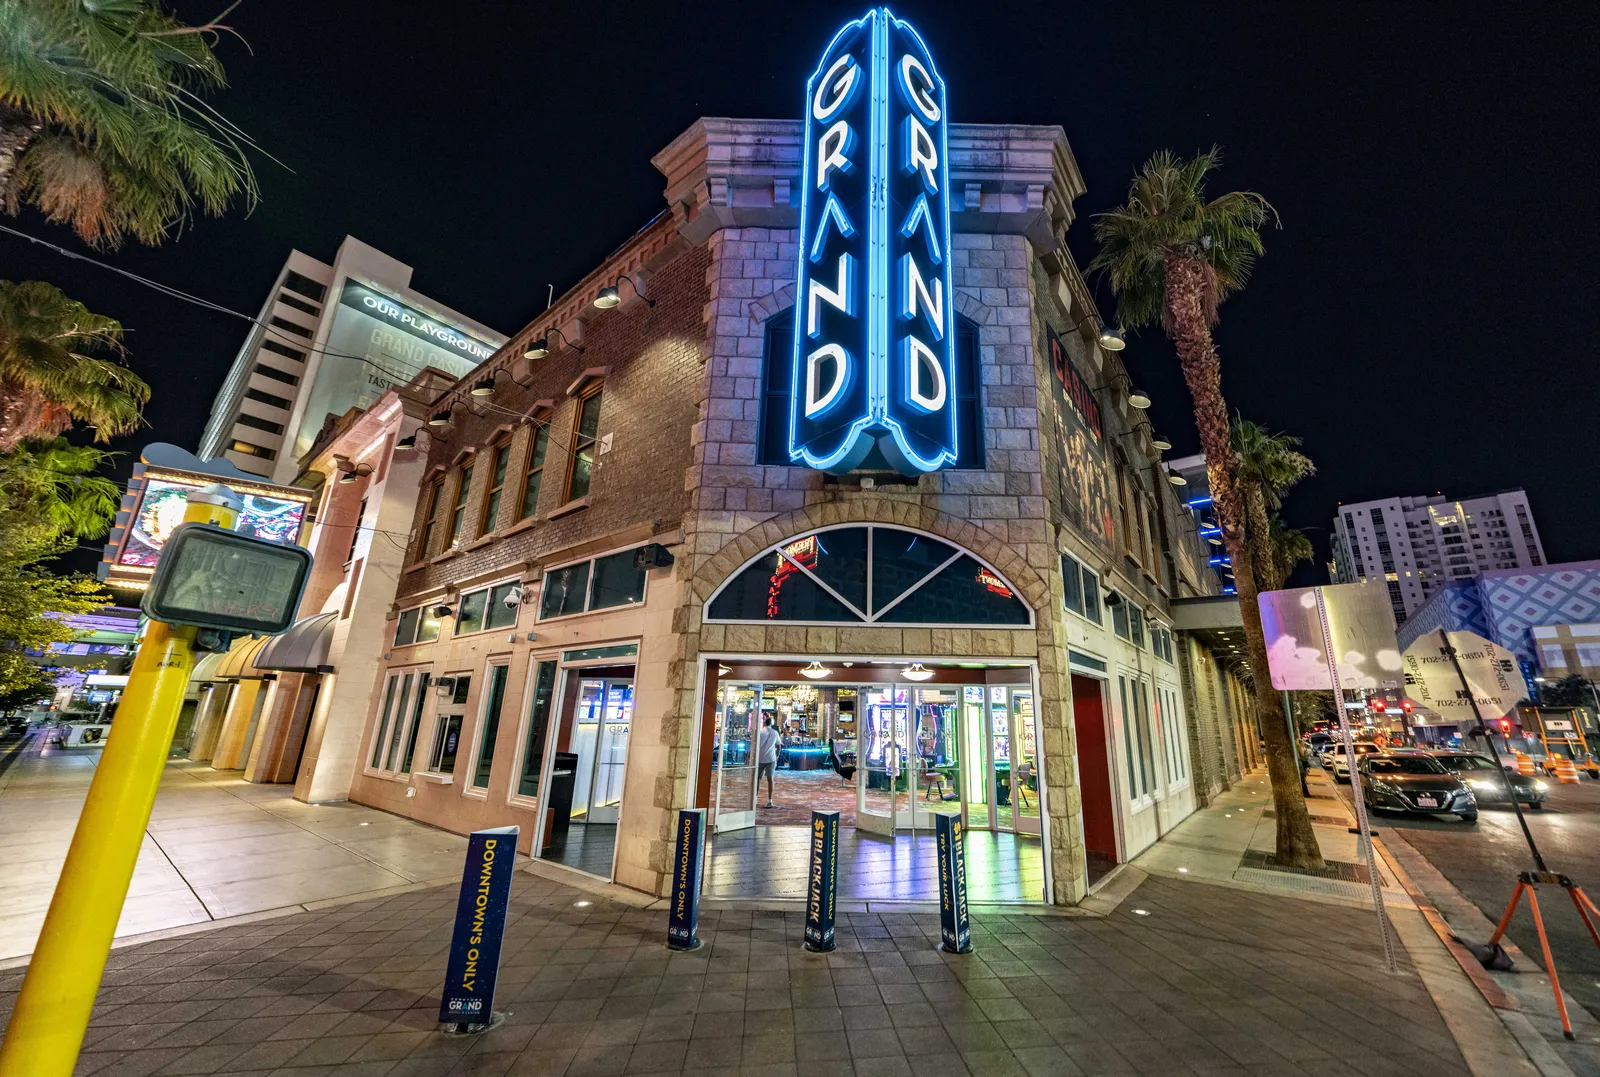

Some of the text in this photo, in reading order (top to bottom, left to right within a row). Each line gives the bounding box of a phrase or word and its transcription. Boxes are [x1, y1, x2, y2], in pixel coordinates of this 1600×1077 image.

[804, 53, 860, 419] GRAND
[897, 53, 947, 415] GRAND
[363, 296, 399, 319] OUR
[370, 328, 425, 362] GRAND
[1052, 338, 1102, 440] CASINO
[1435, 697, 1503, 708] 702-27-0651
[679, 818, 691, 889] DOWNTOWN'S
[809, 839, 823, 922] BLACKJACK
[829, 820, 837, 891] DOWNTOWN'S
[941, 854, 949, 882] YOUR
[469, 839, 497, 945] DOWNTOWN'S
[677, 891, 686, 920] ONLY
[954, 841, 967, 925] BLACKJACK
[669, 926, 689, 938] GRAND
[462, 948, 479, 992] ONLY
[448, 1000, 483, 1011] GRAND
